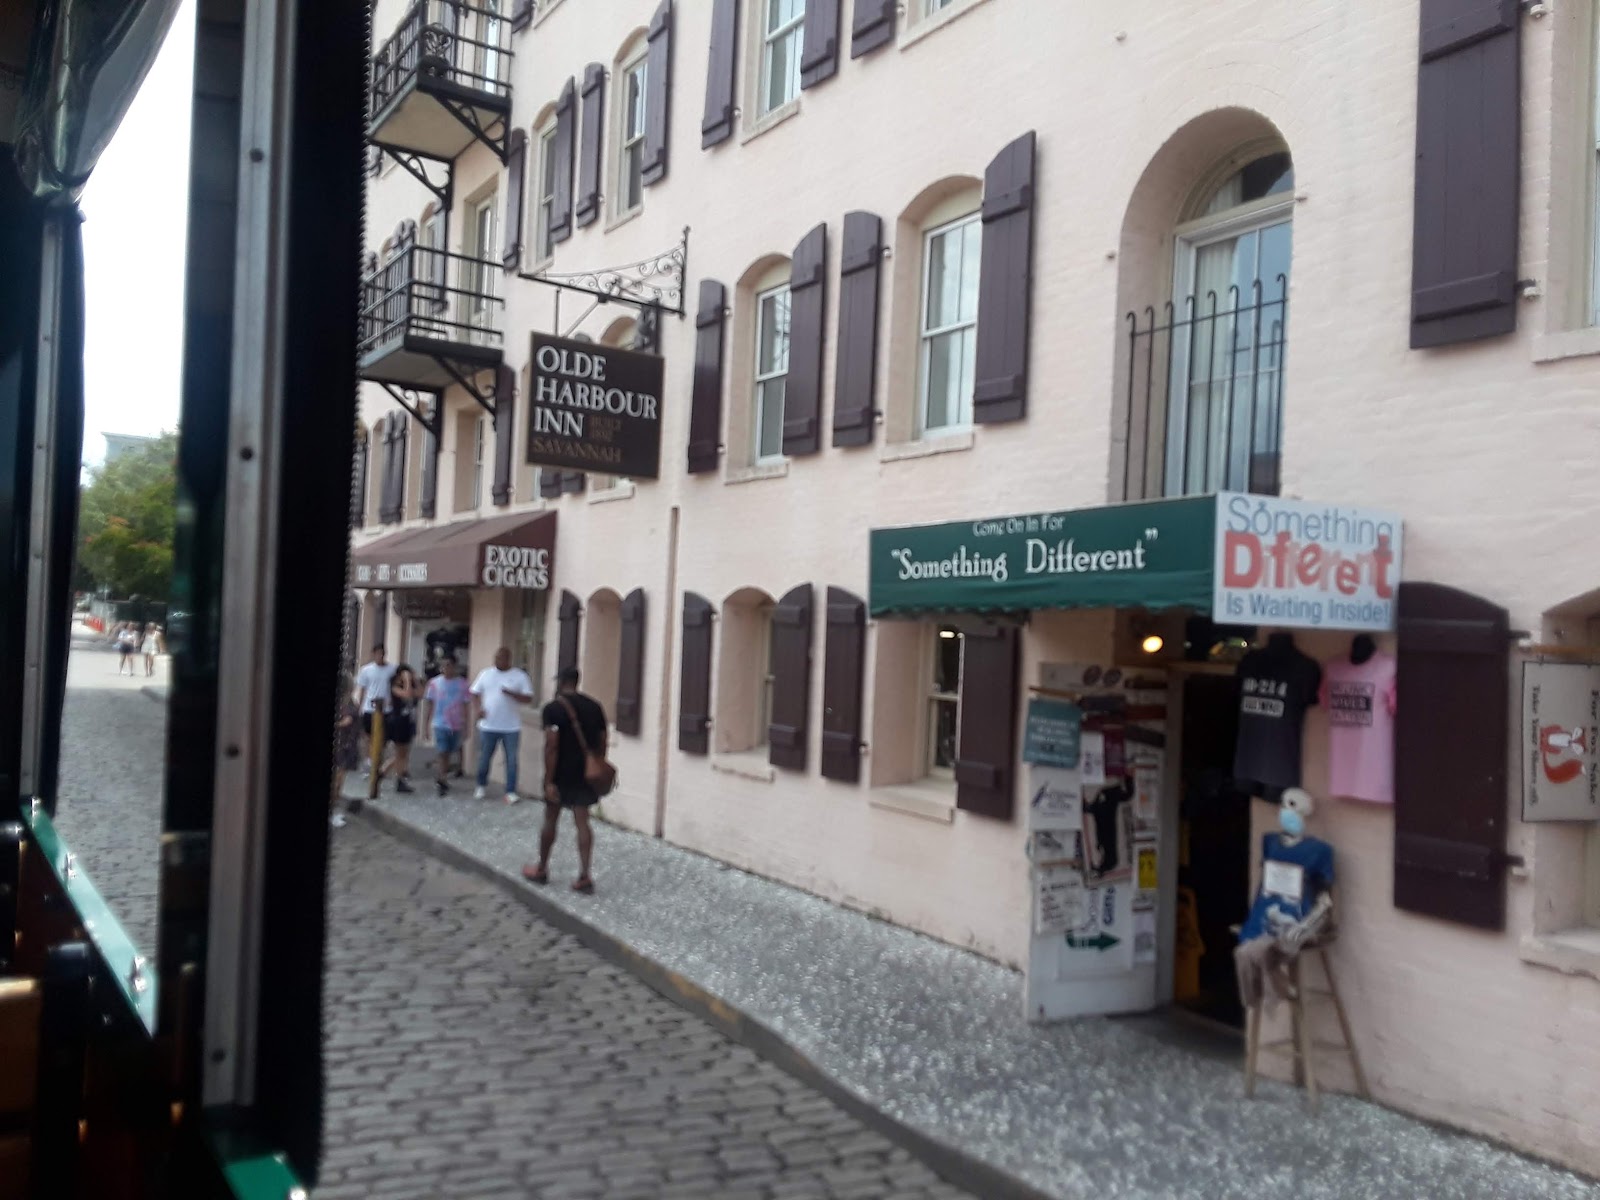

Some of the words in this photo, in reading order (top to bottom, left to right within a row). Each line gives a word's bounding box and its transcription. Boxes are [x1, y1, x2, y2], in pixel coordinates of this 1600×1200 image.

[536, 345, 607, 381] OLDE
[535, 375, 658, 420] HARBOUR
[534, 406, 584, 437] INN
[532, 437, 621, 463] SAVANNAH
[972, 521, 1005, 537] Come
[1006, 517, 1024, 534] On
[1026, 516, 1039, 533] In
[1041, 514, 1065, 531] For
[485, 544, 550, 568] EXOTIC
[482, 565, 550, 590] CIGARS
[1226, 591, 1243, 616] Is
[1250, 592, 1323, 624] Waiting
[1328, 599, 1390, 625] Inside!
